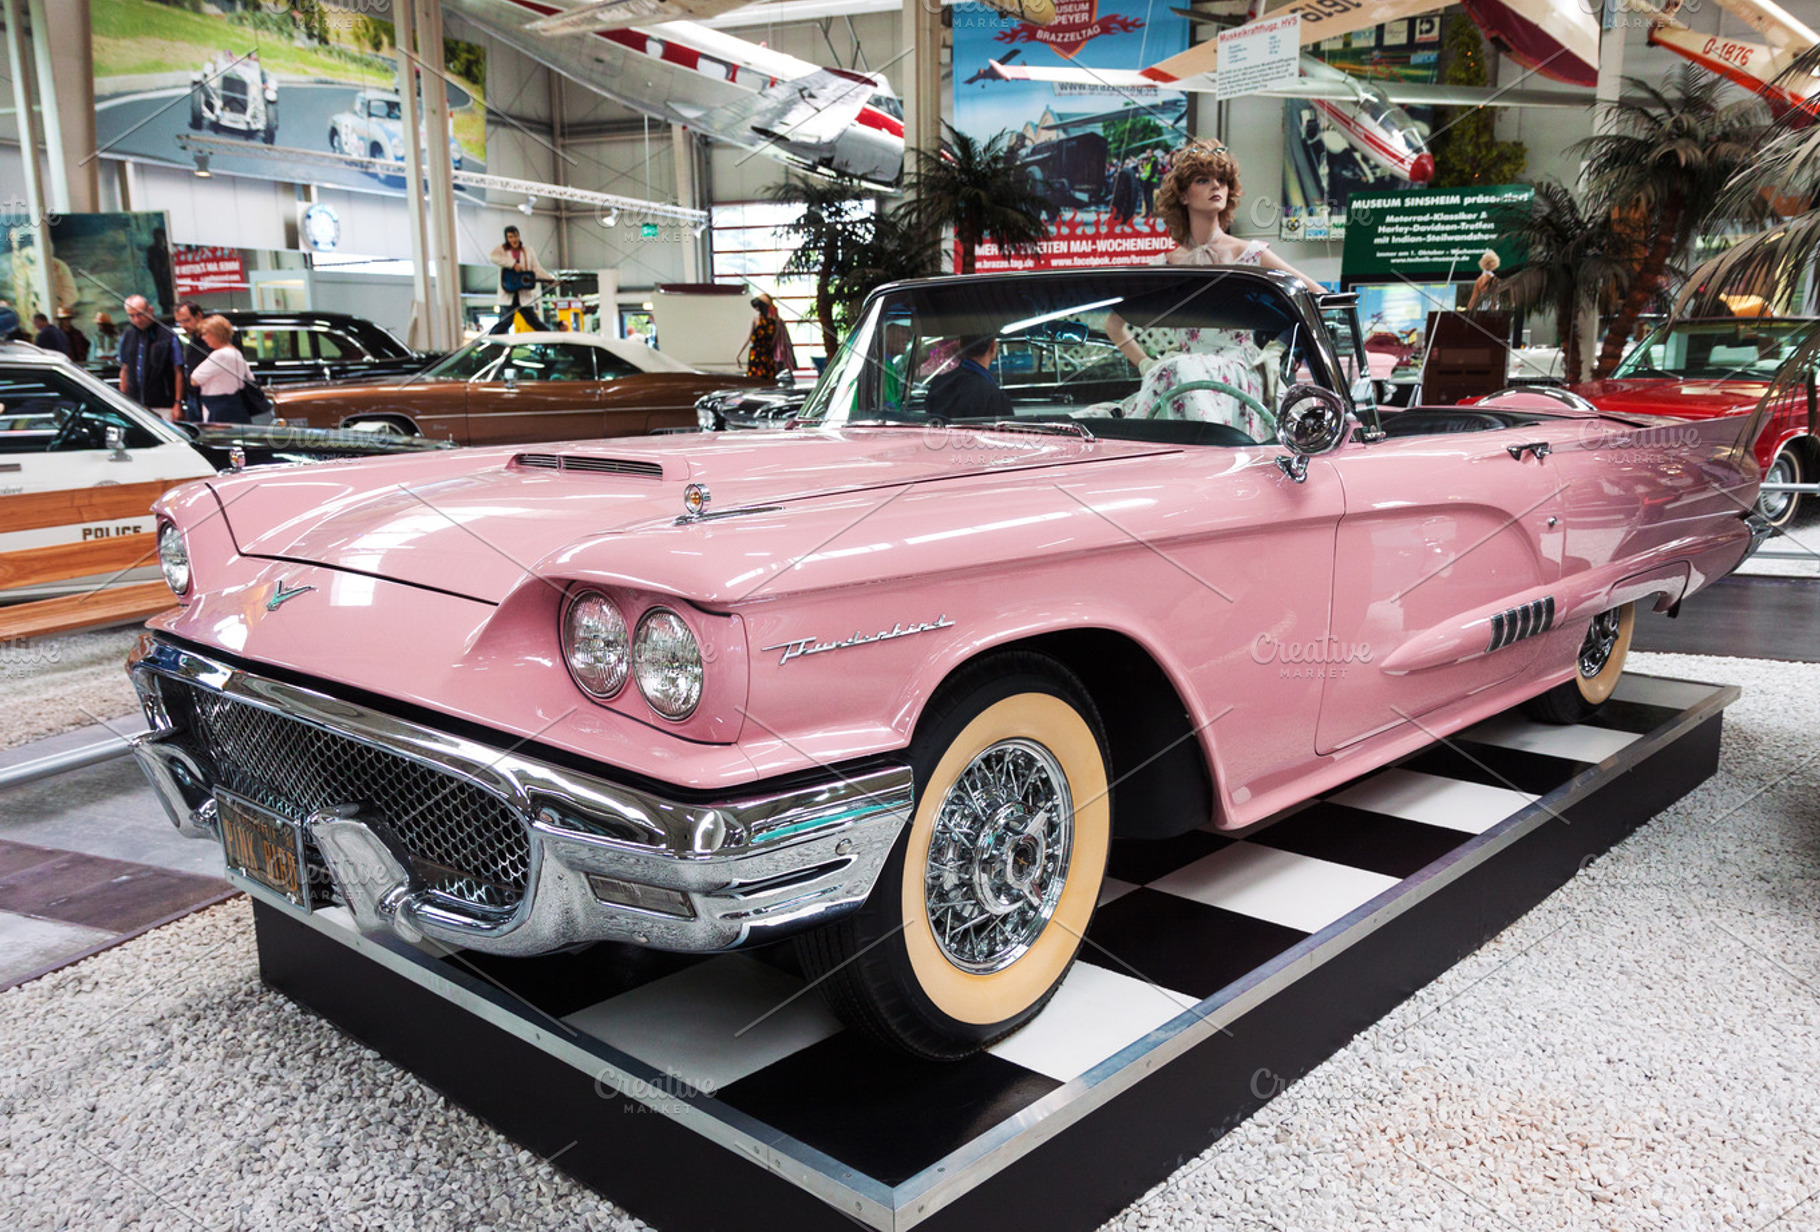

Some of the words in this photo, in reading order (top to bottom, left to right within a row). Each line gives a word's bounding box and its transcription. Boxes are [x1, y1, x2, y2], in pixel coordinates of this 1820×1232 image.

[1055, 2, 1089, 14] USEUM
[1281, 16, 1298, 29] HVS
[1036, 25, 1101, 42] BRAZZELTAG
[1351, 198, 1401, 210] MUSEUM
[1404, 194, 1460, 207] SINSHEIM
[1385, 212, 1477, 223] Motorrad-Klassiker
[1479, 211, 1488, 219] &
[1378, 221, 1495, 234] Harley-Davidson-Treffen
[1070, 236, 1176, 253] MAI-WOCHENENDE
[1373, 234, 1389, 244] mit
[1391, 232, 1498, 243] Indian-Steilwandshow
[82, 525, 142, 541] POLICE
[761, 614, 956, 666] Thunderbird
[224, 818, 258, 870] PINK
[263, 840, 298, 891] BIRD
